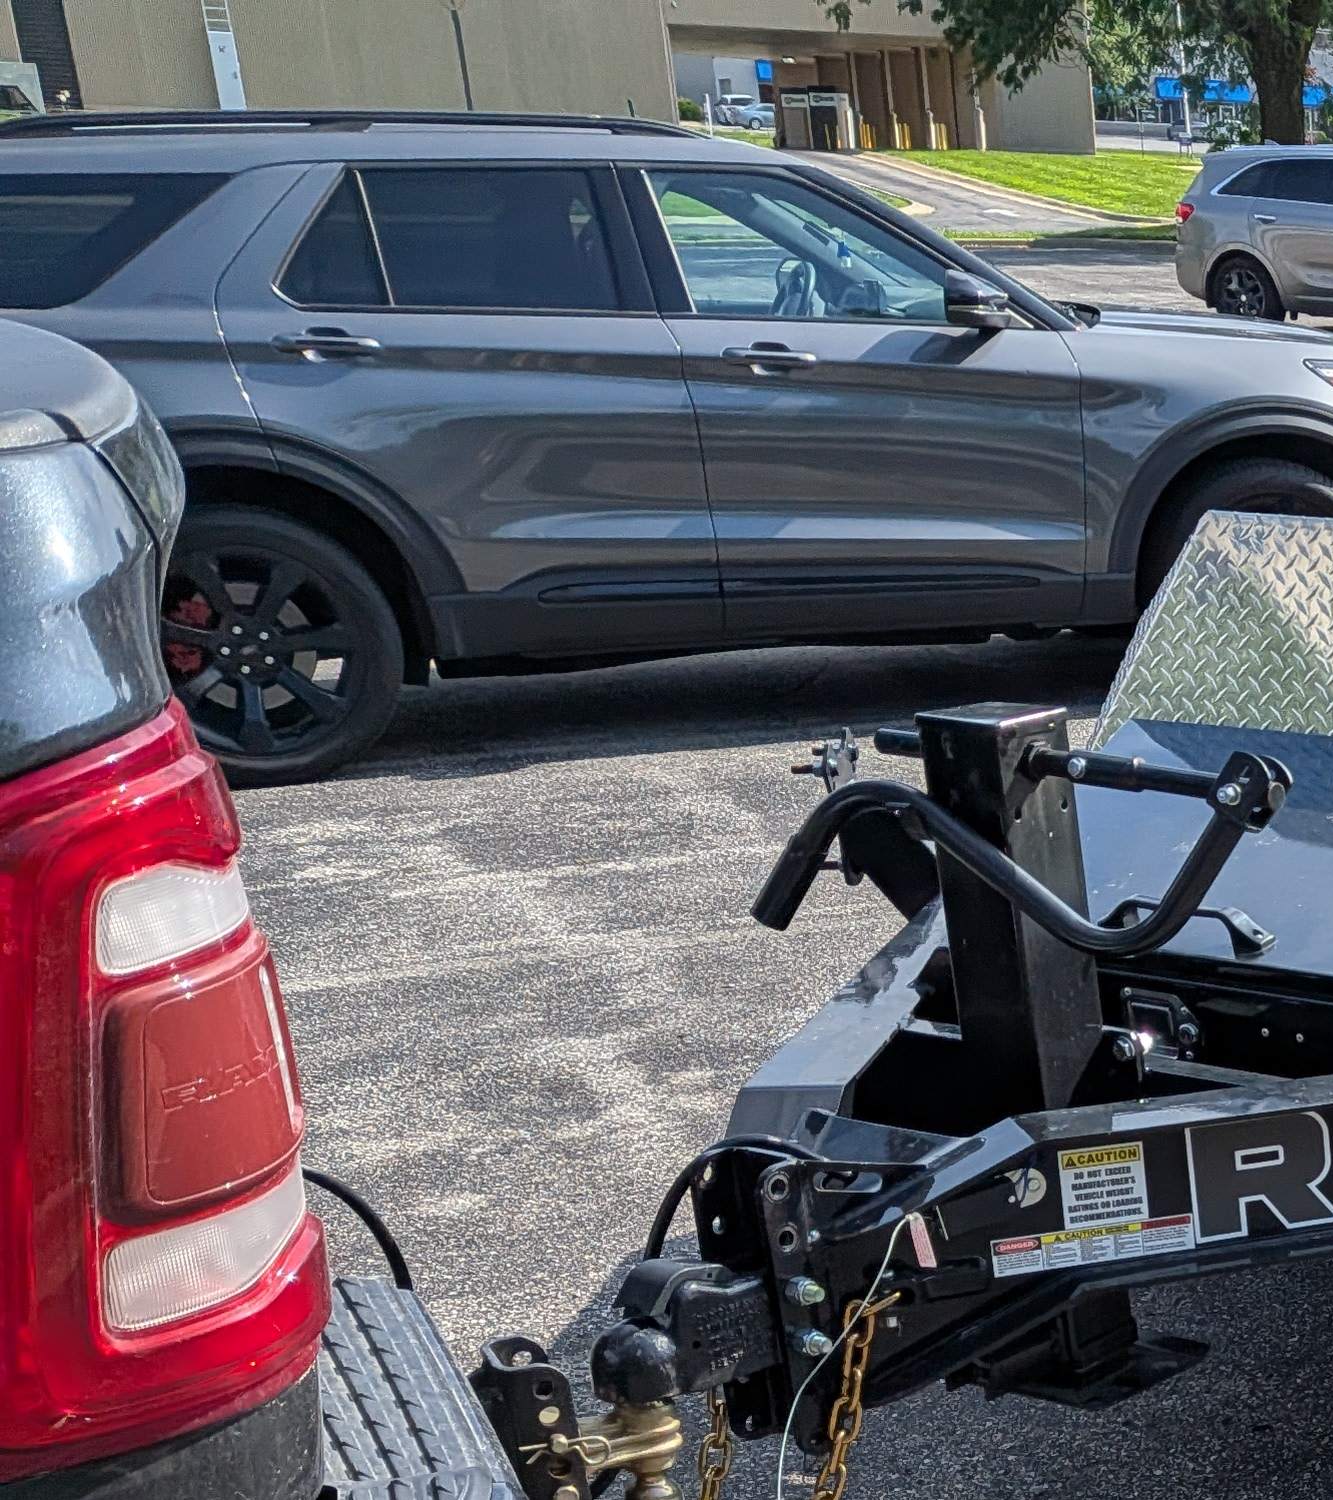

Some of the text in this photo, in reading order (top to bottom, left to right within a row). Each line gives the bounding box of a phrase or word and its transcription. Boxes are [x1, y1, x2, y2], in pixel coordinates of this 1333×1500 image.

[1077, 1148, 1137, 1165] CAUTION
[1073, 1166, 1131, 1180] DO NOT EXCEED
[1071, 1176, 1136, 1191] MANUFACTURER'S
[1074, 1187, 1134, 1201] VEHICLE WEIGHT
[1068, 1196, 1143, 1213] RATINGS OR LOADING
[1069, 1207, 1144, 1224] RECOMMENDATIONS.
[1064, 1228, 1104, 1240] CAUTION
[1000, 1240, 1035, 1251] DANGER
